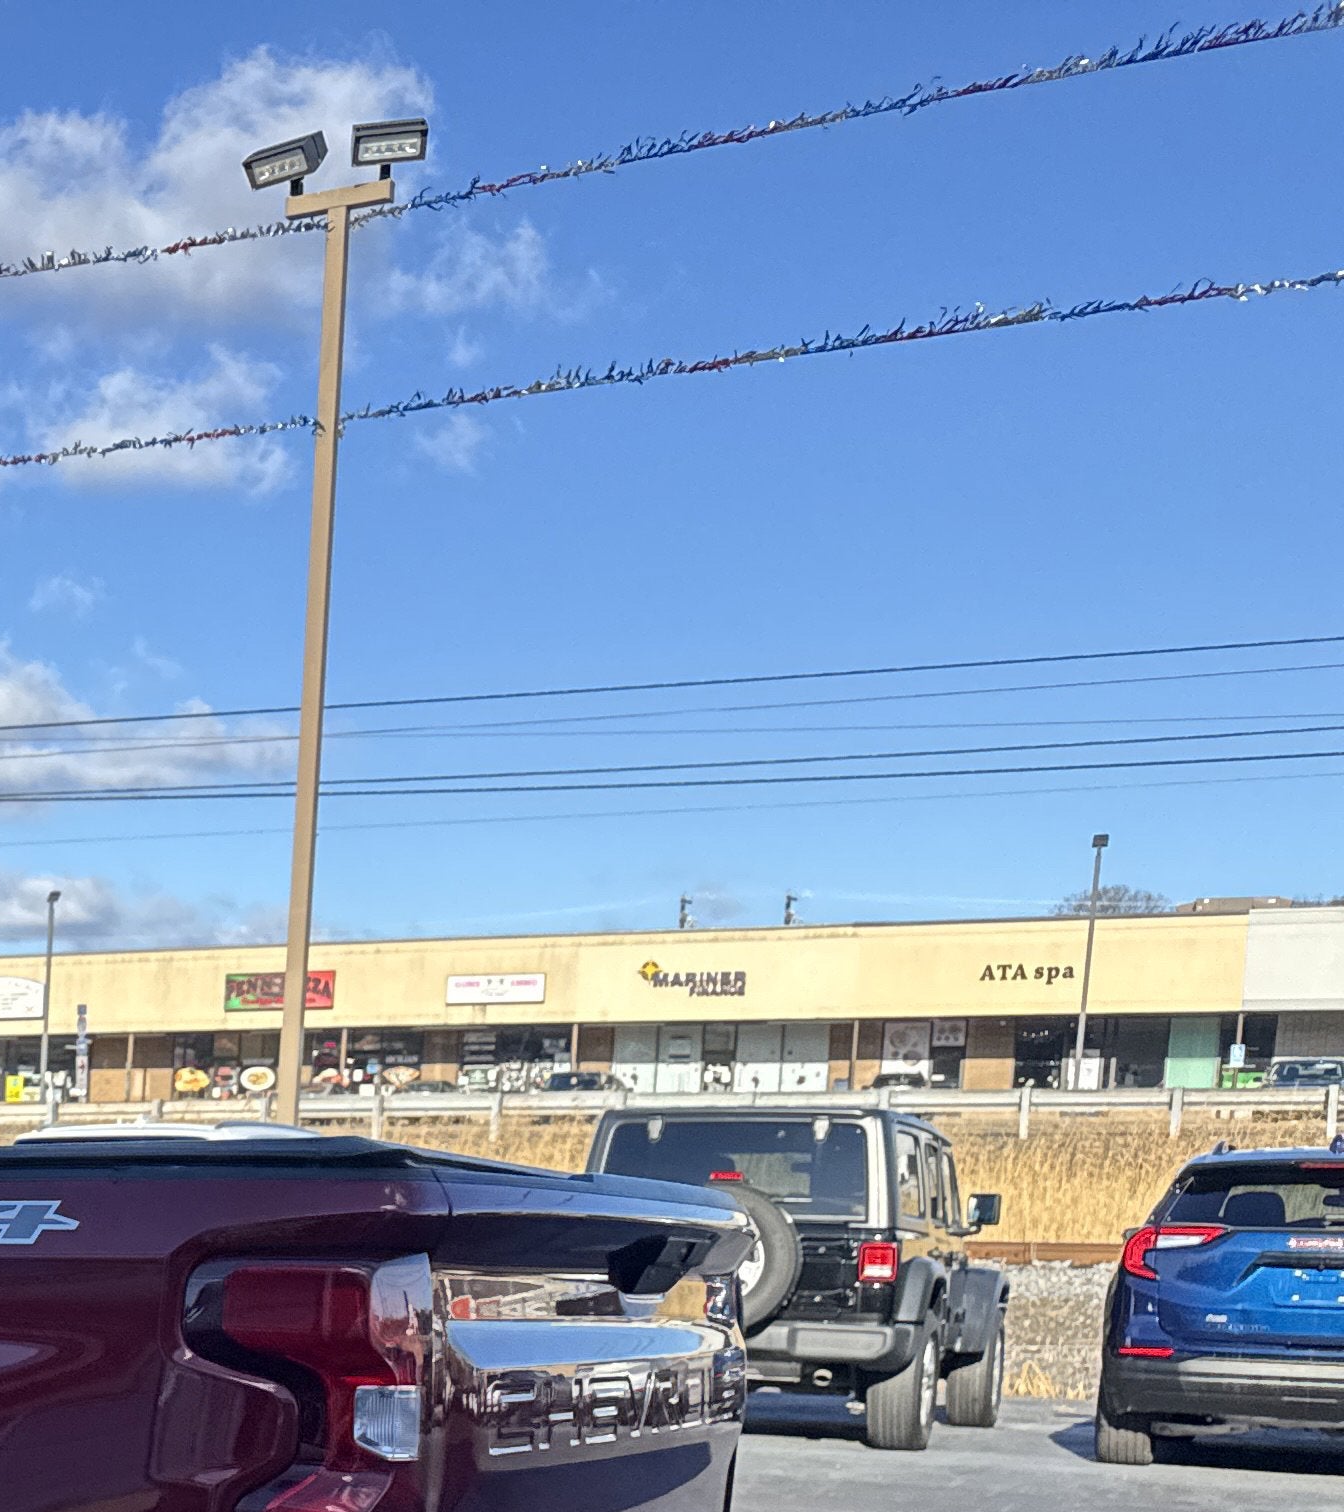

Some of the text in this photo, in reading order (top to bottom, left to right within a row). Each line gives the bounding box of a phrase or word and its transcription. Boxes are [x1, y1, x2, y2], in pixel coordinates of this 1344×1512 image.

[652, 971, 746, 988] MARINER
[979, 963, 1075, 985] ATA spa
